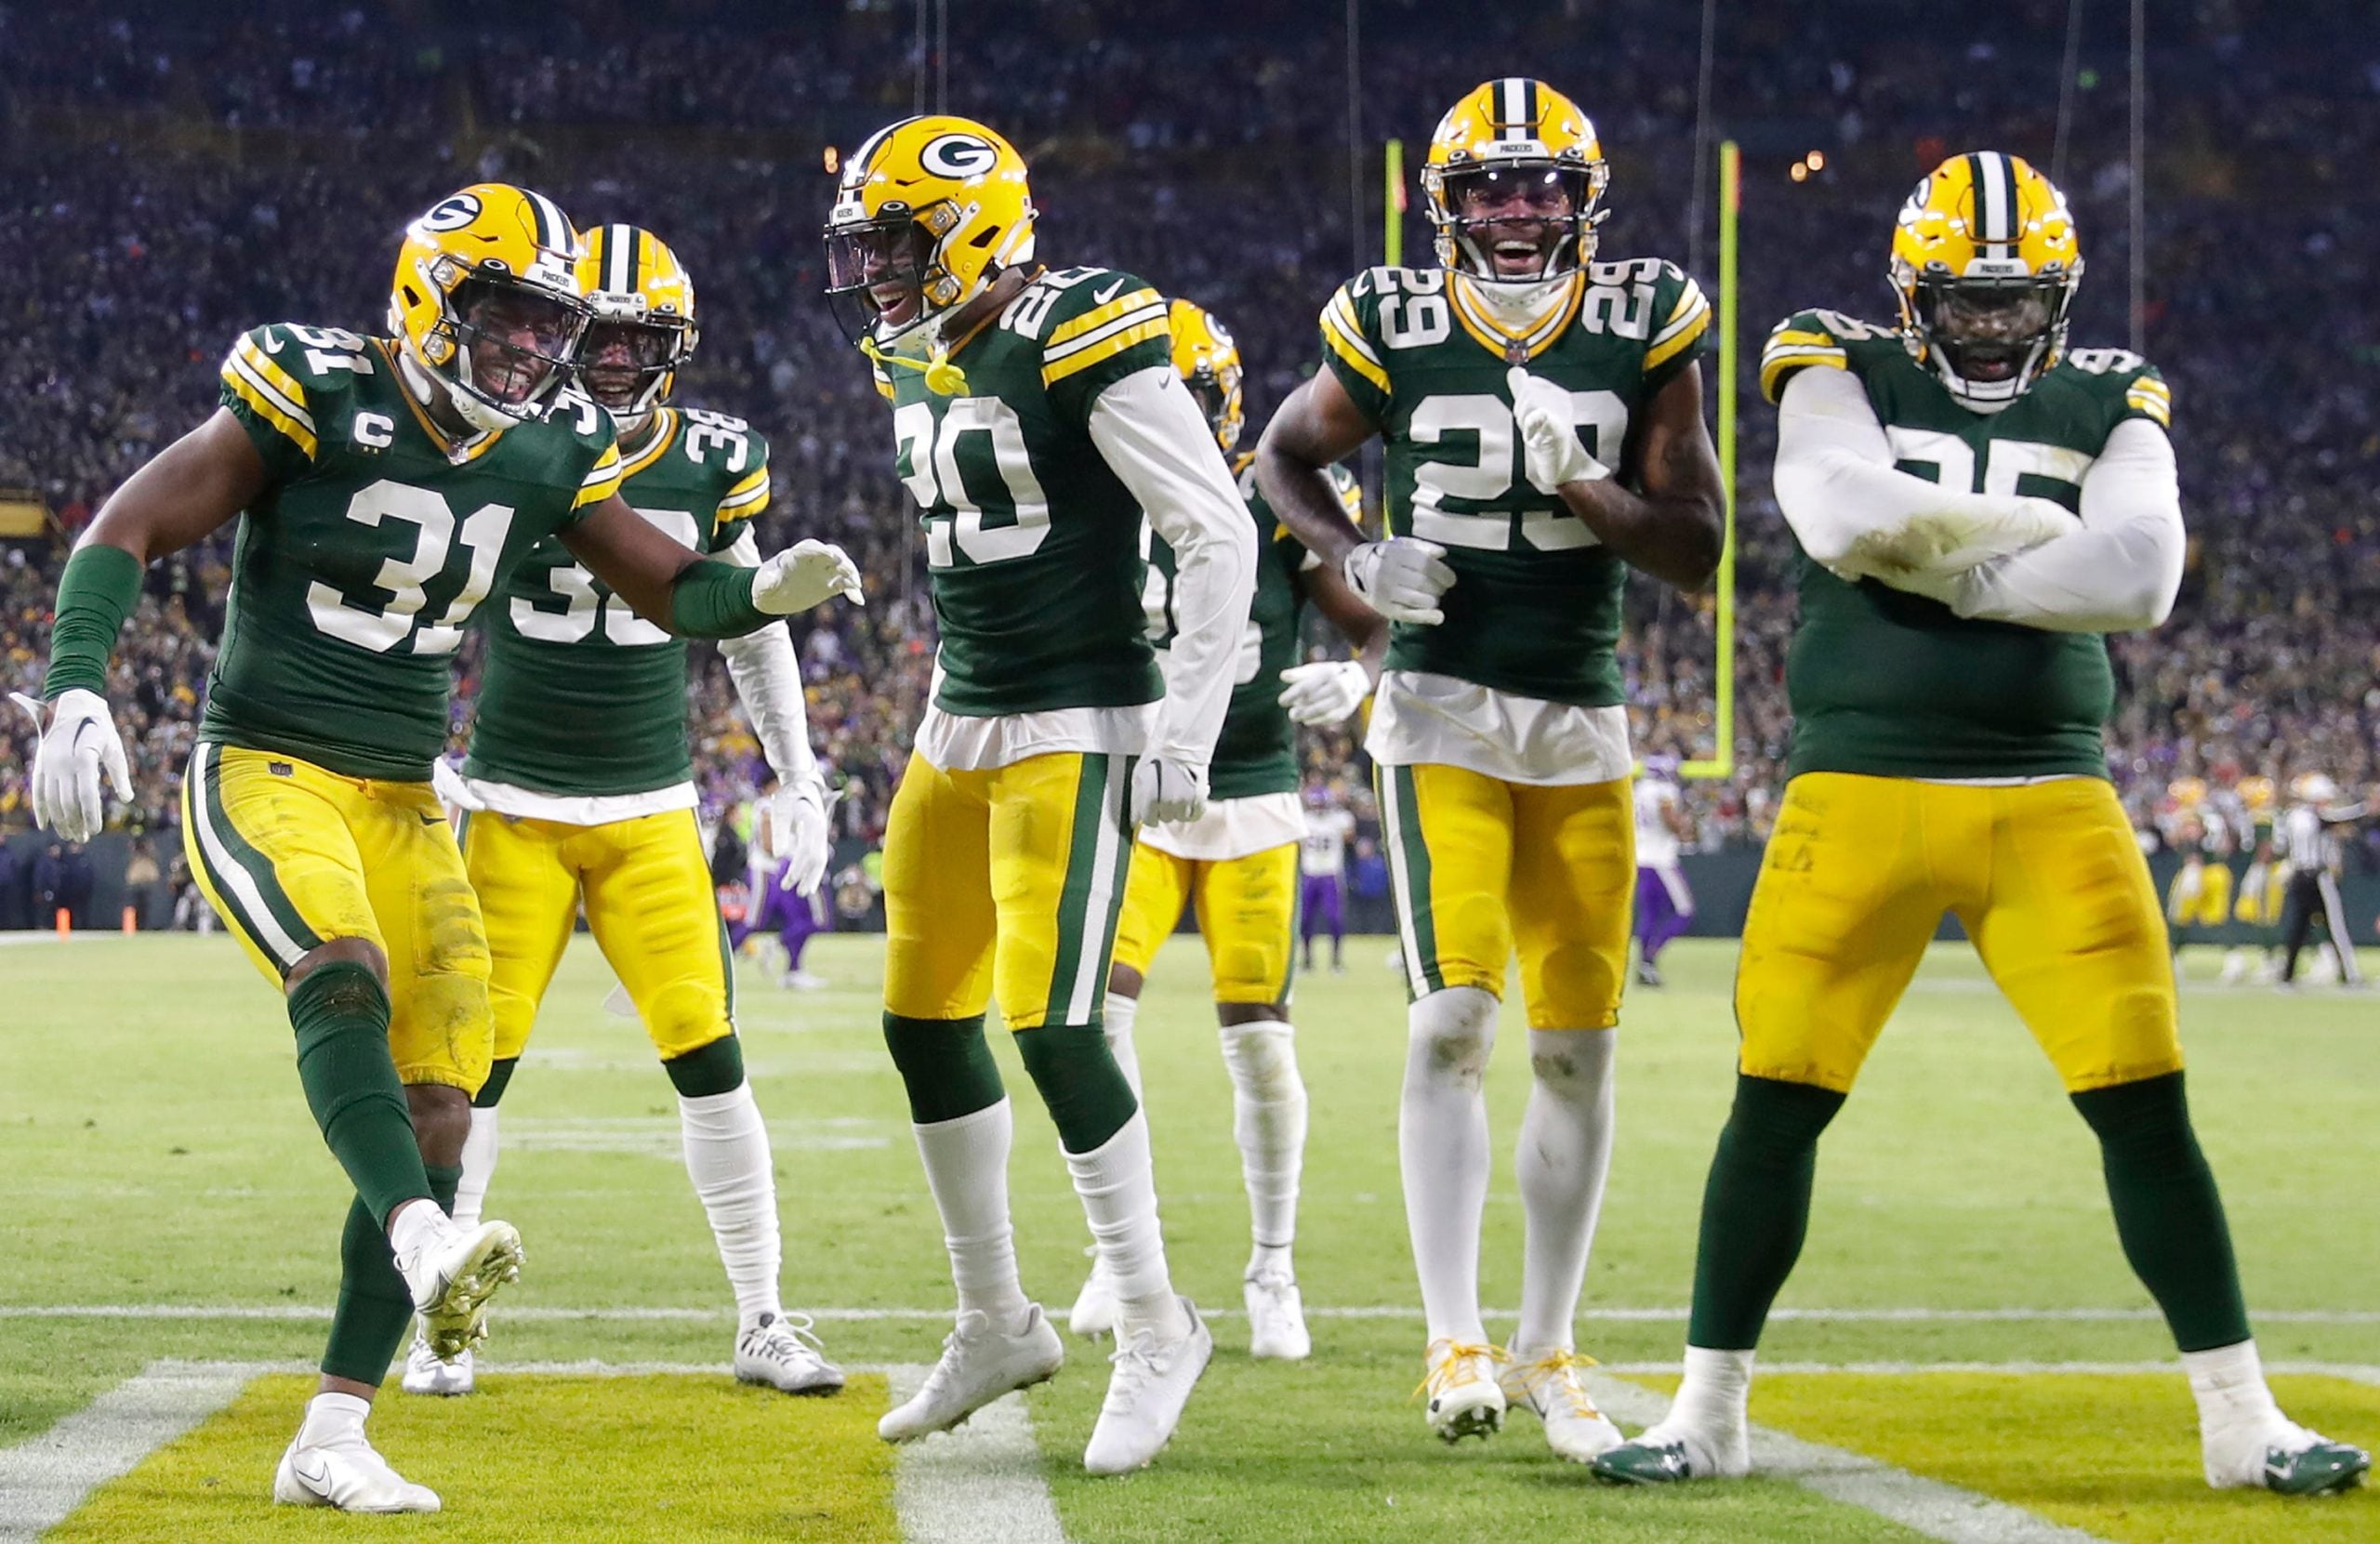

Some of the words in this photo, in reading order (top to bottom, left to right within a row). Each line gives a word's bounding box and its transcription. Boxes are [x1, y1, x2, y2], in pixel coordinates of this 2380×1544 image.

[919, 133, 997, 180] G
[542, 270, 570, 286] PACKERS
[1369, 266, 1450, 350] 29
[1581, 257, 1661, 340] 29
[284, 322, 374, 375] 31
[354, 412, 394, 448] C
[685, 407, 748, 472] 38
[893, 396, 1052, 567] 20
[306, 479, 515, 654] 31
